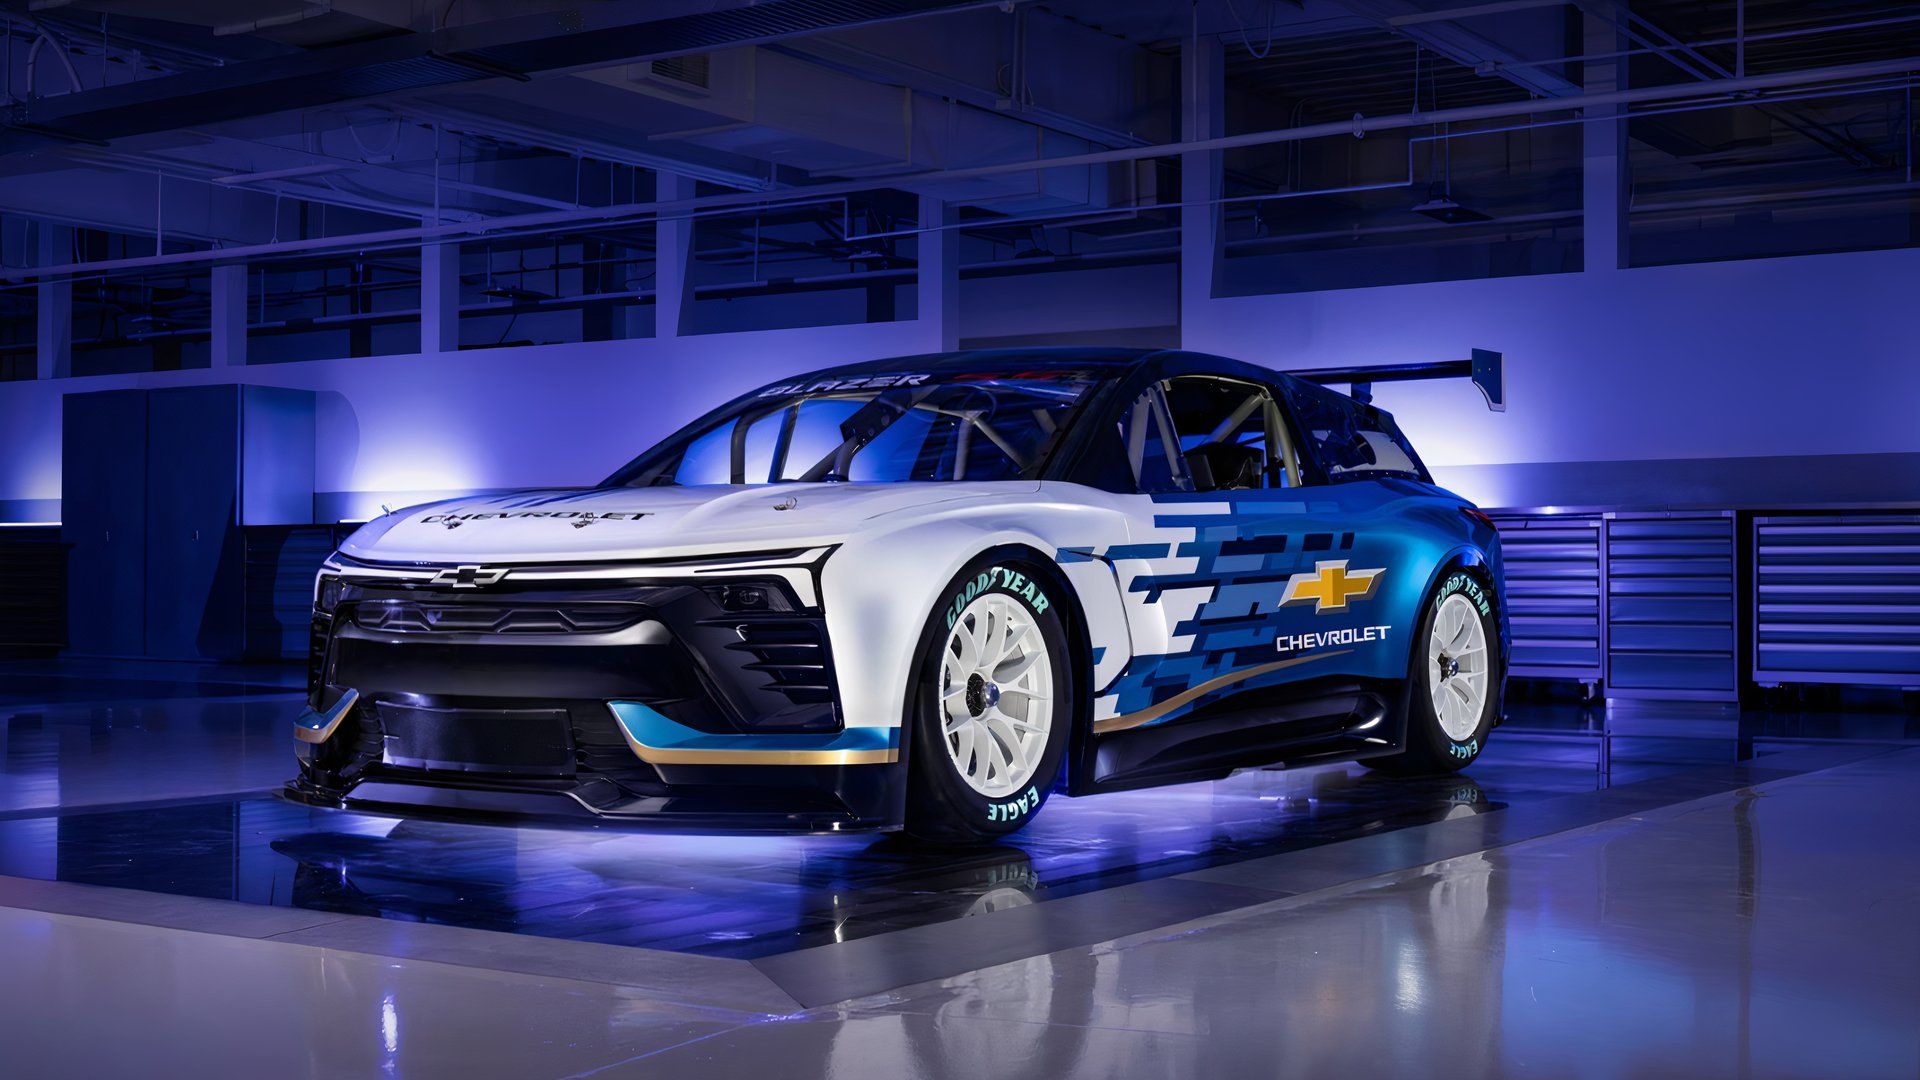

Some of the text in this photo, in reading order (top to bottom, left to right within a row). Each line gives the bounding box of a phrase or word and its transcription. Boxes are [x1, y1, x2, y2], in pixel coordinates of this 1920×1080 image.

[758, 374, 931, 397] BLAZER
[946, 566, 1049, 630] GOODYEAR
[1436, 574, 1490, 616] GOODYEAR
[1276, 625, 1391, 652] CHEVROLET
[1449, 739, 1478, 759] EAGLE
[987, 785, 1040, 822] EAGLE
